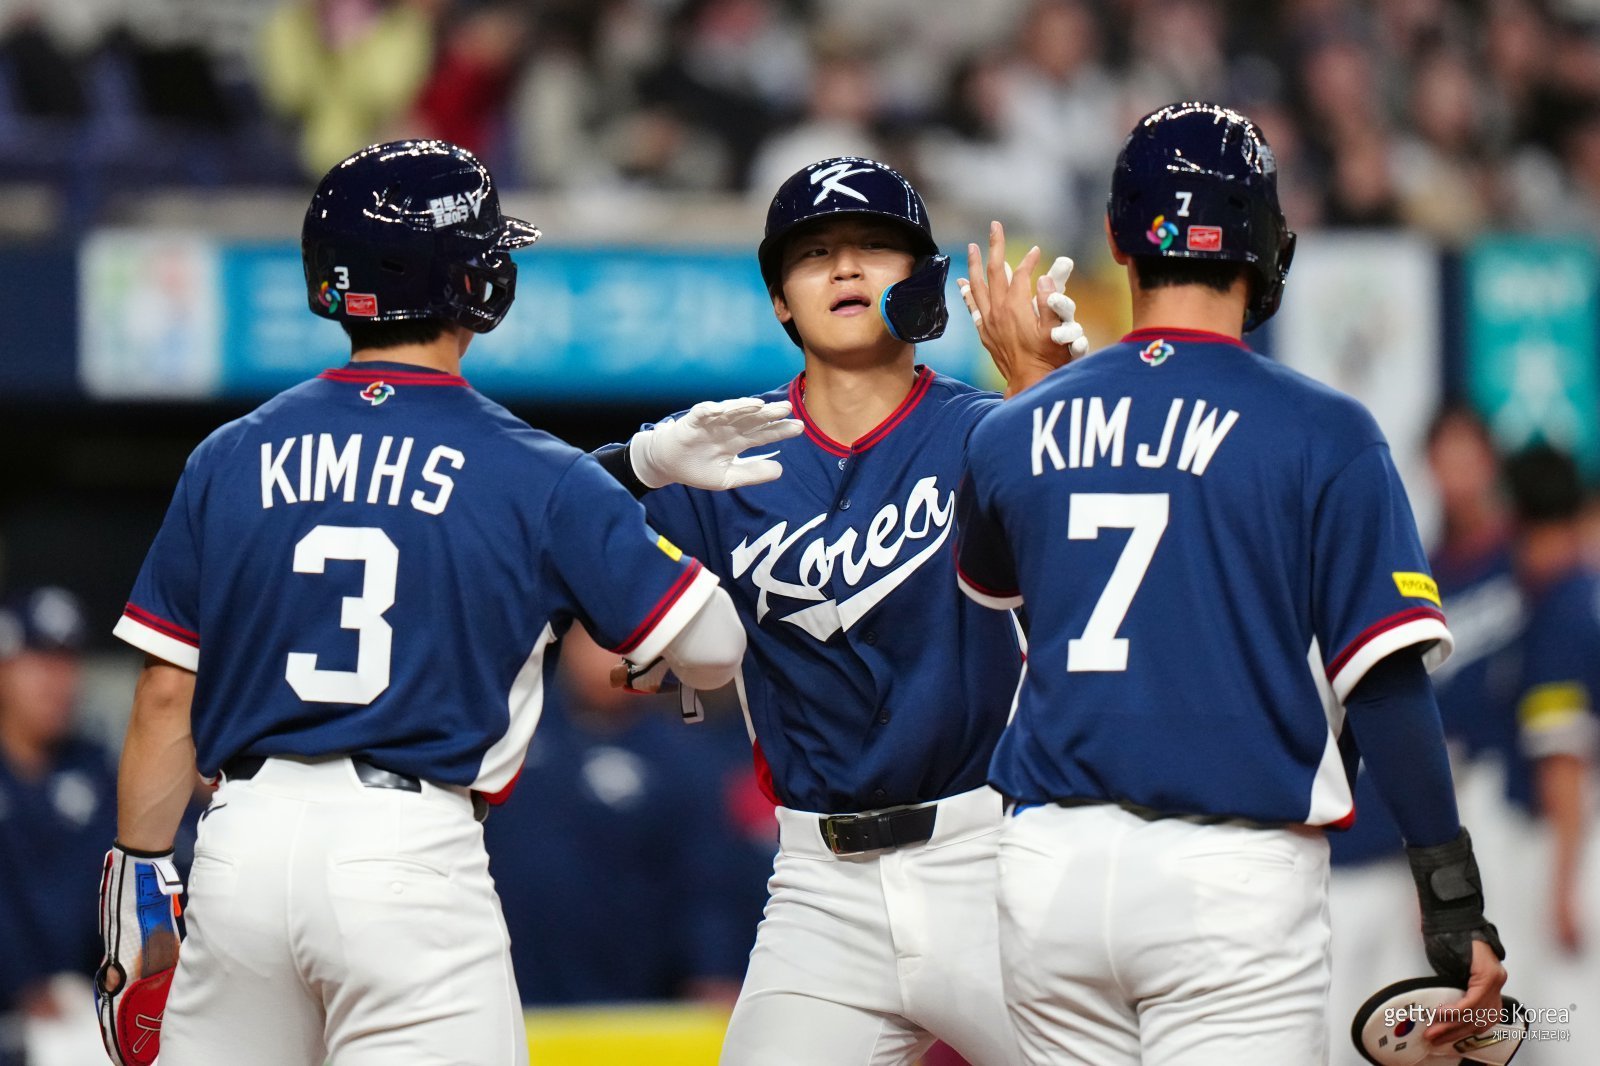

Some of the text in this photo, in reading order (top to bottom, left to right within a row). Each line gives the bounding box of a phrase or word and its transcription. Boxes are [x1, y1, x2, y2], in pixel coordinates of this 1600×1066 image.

[1175, 191, 1193, 217] 7
[334, 266, 350, 290] 3
[1031, 396, 1132, 476] KIM
[285, 524, 400, 706] 3
[730, 475, 956, 642] Korea
[1066, 492, 1170, 673] 7
